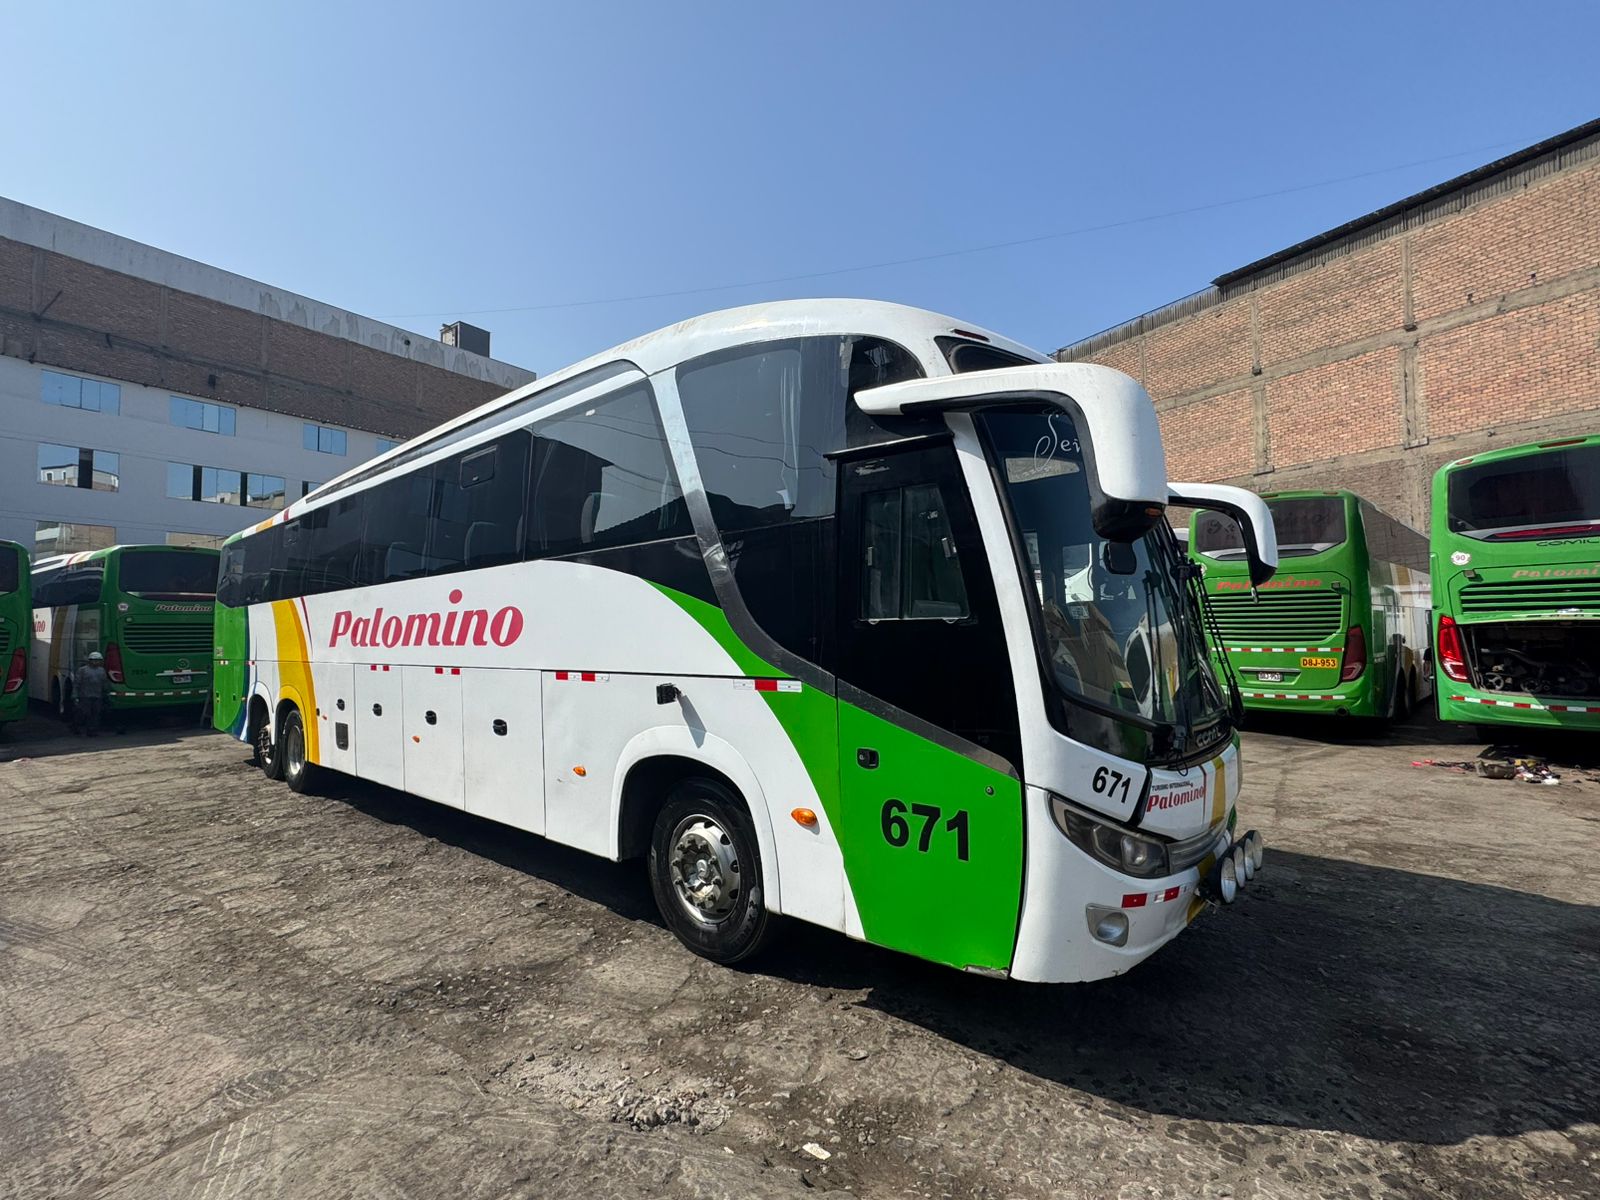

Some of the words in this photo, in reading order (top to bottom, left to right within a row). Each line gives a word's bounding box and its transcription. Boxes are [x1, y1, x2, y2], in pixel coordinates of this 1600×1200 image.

[329, 588, 524, 648] Palomino
[1302, 658, 1338, 668] D8J-953
[1092, 766, 1132, 804] 671
[1146, 785, 1206, 812] Palomino
[881, 798, 969, 862] 671
